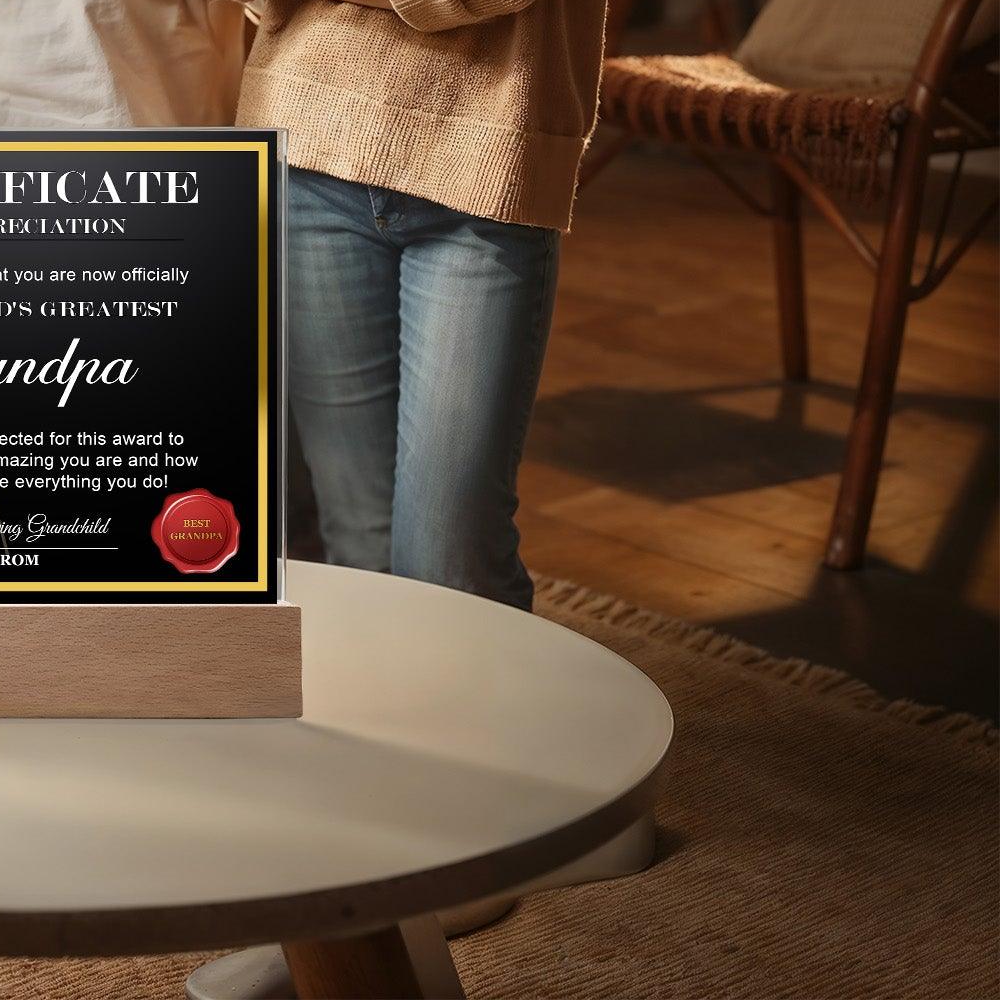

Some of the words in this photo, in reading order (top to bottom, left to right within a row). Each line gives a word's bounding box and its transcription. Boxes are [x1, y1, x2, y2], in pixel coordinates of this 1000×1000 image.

[13, 270, 44, 285] you
[49, 270, 76, 282] are
[82, 270, 117, 282] now
[121, 267, 190, 285] officially
[40, 301, 178, 317] GREATEST
[49, 431, 72, 446] for
[77, 431, 107, 446] this
[112, 431, 163, 446] award
[168, 431, 184, 446] to
[59, 456, 90, 471] you
[95, 455, 123, 467] are
[128, 452, 158, 467] and
[165, 452, 199, 467] how
[14, 474, 101, 492] everything
[106, 477, 137, 492] you
[142, 474, 168, 489] do!
[24, 511, 113, 544] Grandchild
[183, 518, 212, 529] BEST
[169, 531, 224, 541] GRANDPA
